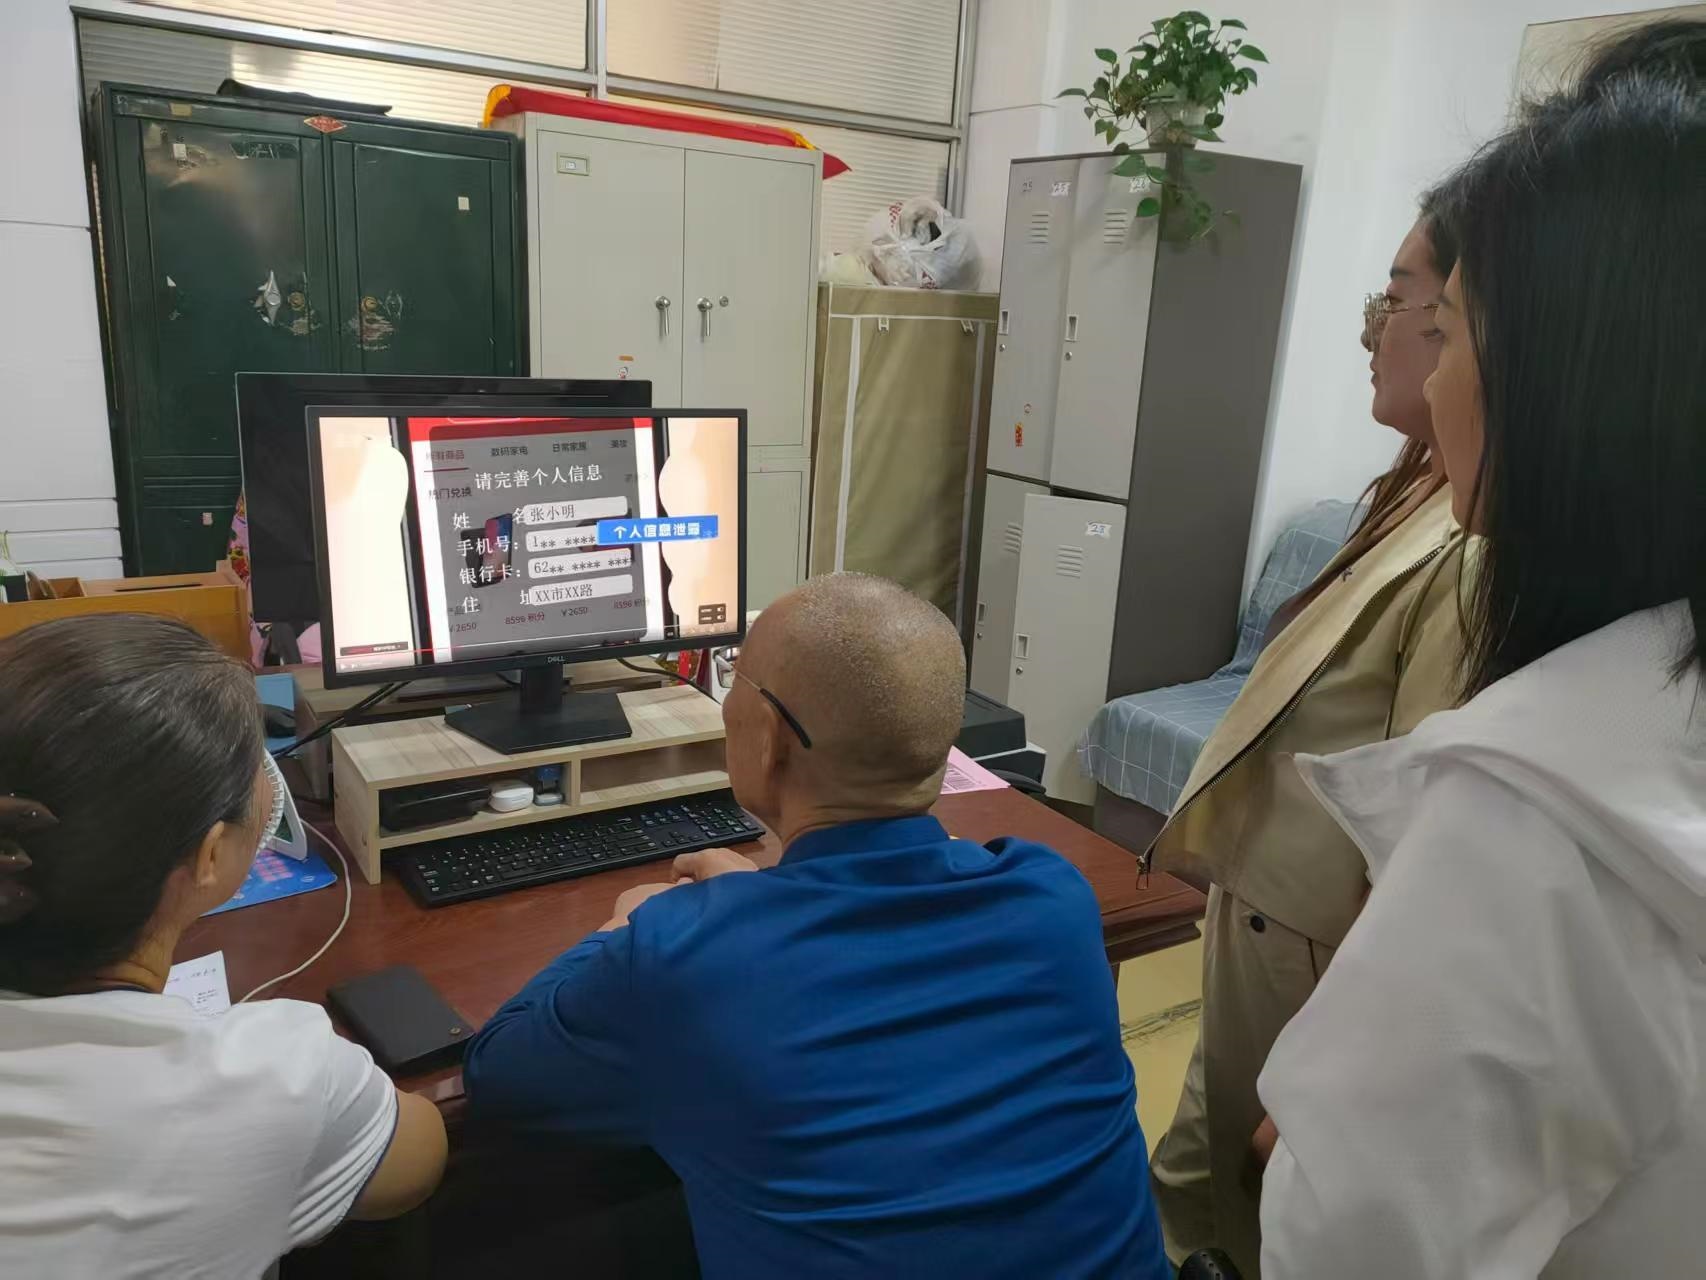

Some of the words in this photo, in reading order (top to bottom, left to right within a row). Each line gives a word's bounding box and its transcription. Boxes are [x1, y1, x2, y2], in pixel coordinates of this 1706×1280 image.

[474, 463, 603, 491] 请完善个人信息
[453, 511, 472, 531] 姓
[530, 504, 576, 522] 张小明
[612, 521, 701, 540] 个人信息泄露
[534, 583, 593, 603] XX市XX路
